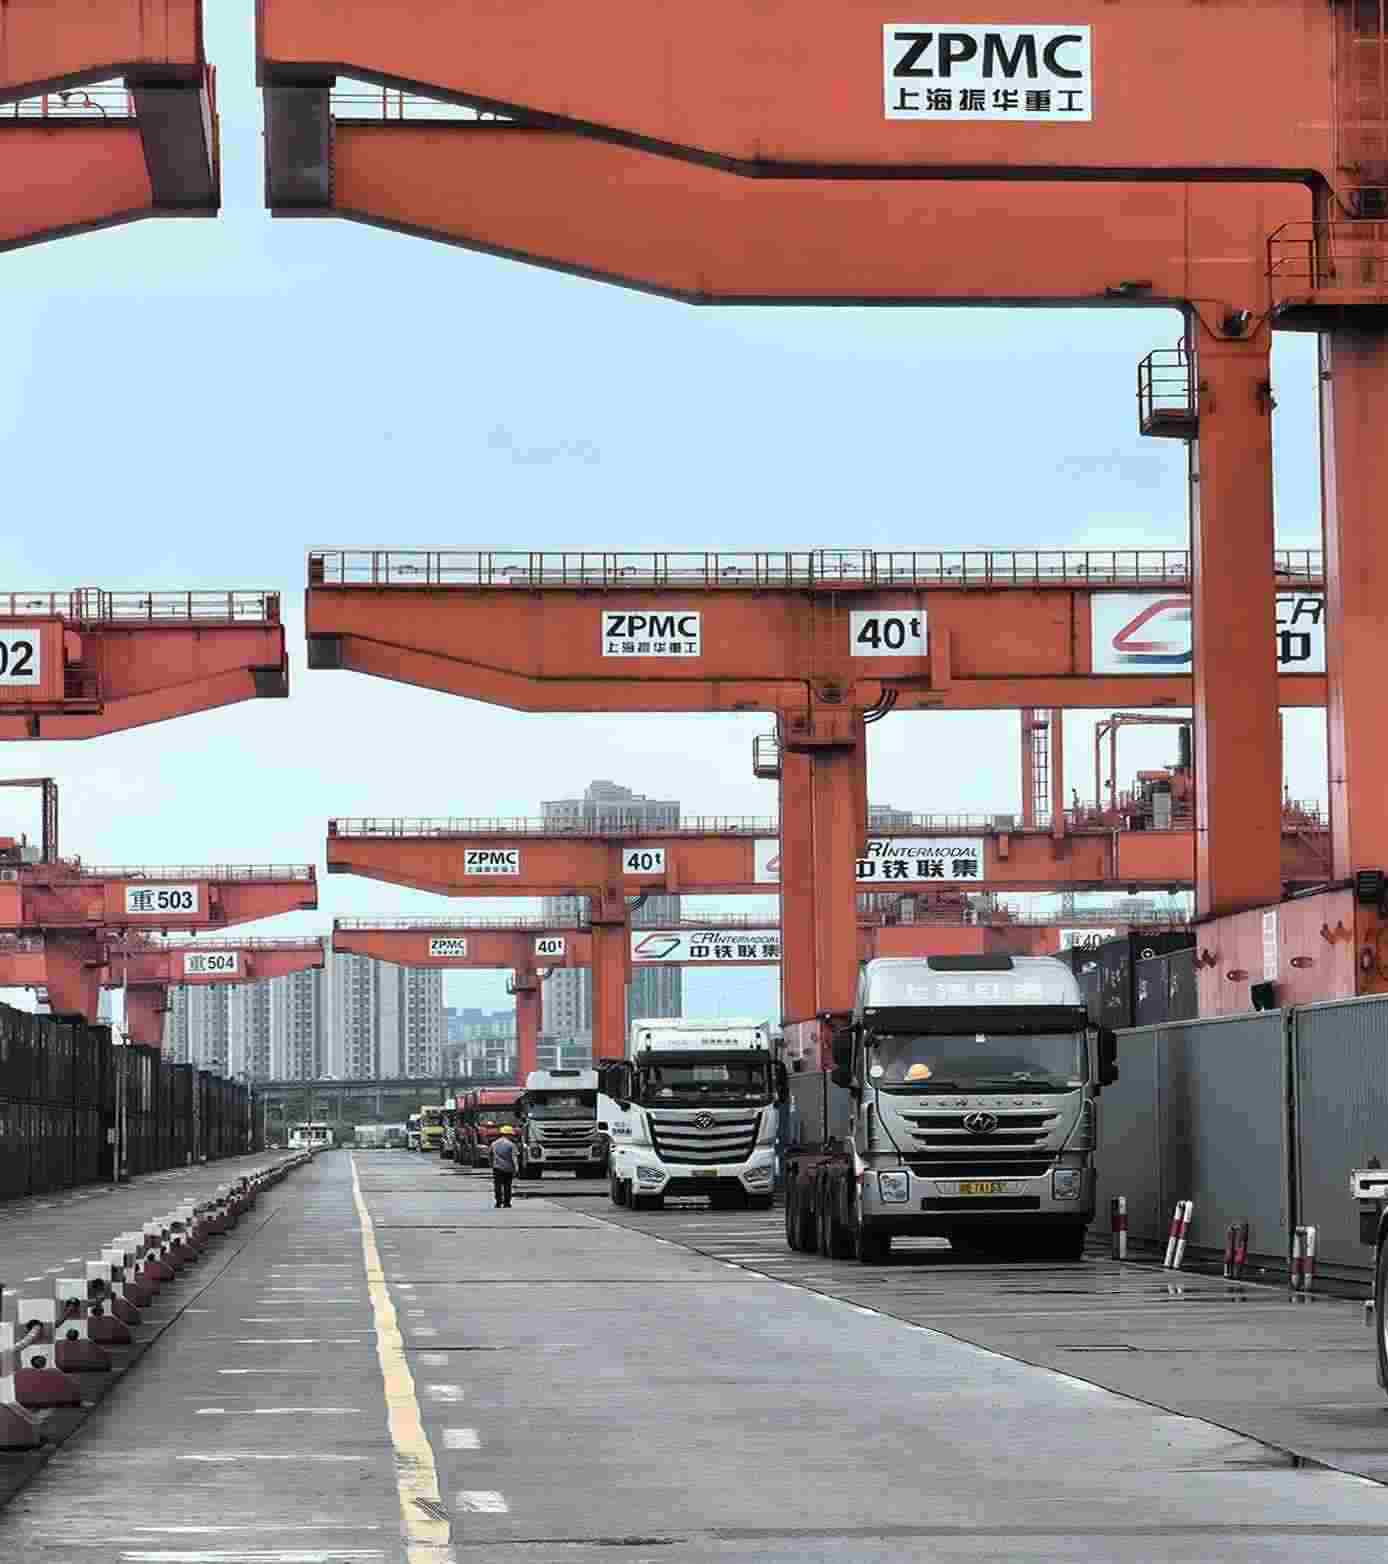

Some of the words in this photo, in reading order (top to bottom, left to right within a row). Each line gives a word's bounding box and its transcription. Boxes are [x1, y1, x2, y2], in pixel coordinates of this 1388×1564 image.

[893, 32, 1083, 78] ZPMC
[893, 87, 1084, 112] 上海振华重工
[606, 615, 697, 637] ZPMC
[857, 617, 921, 649] 40t
[0, 640, 33, 677] 2
[466, 851, 517, 865] ZPMC
[628, 852, 661, 871] 40t
[431, 940, 464, 949] ZPMC
